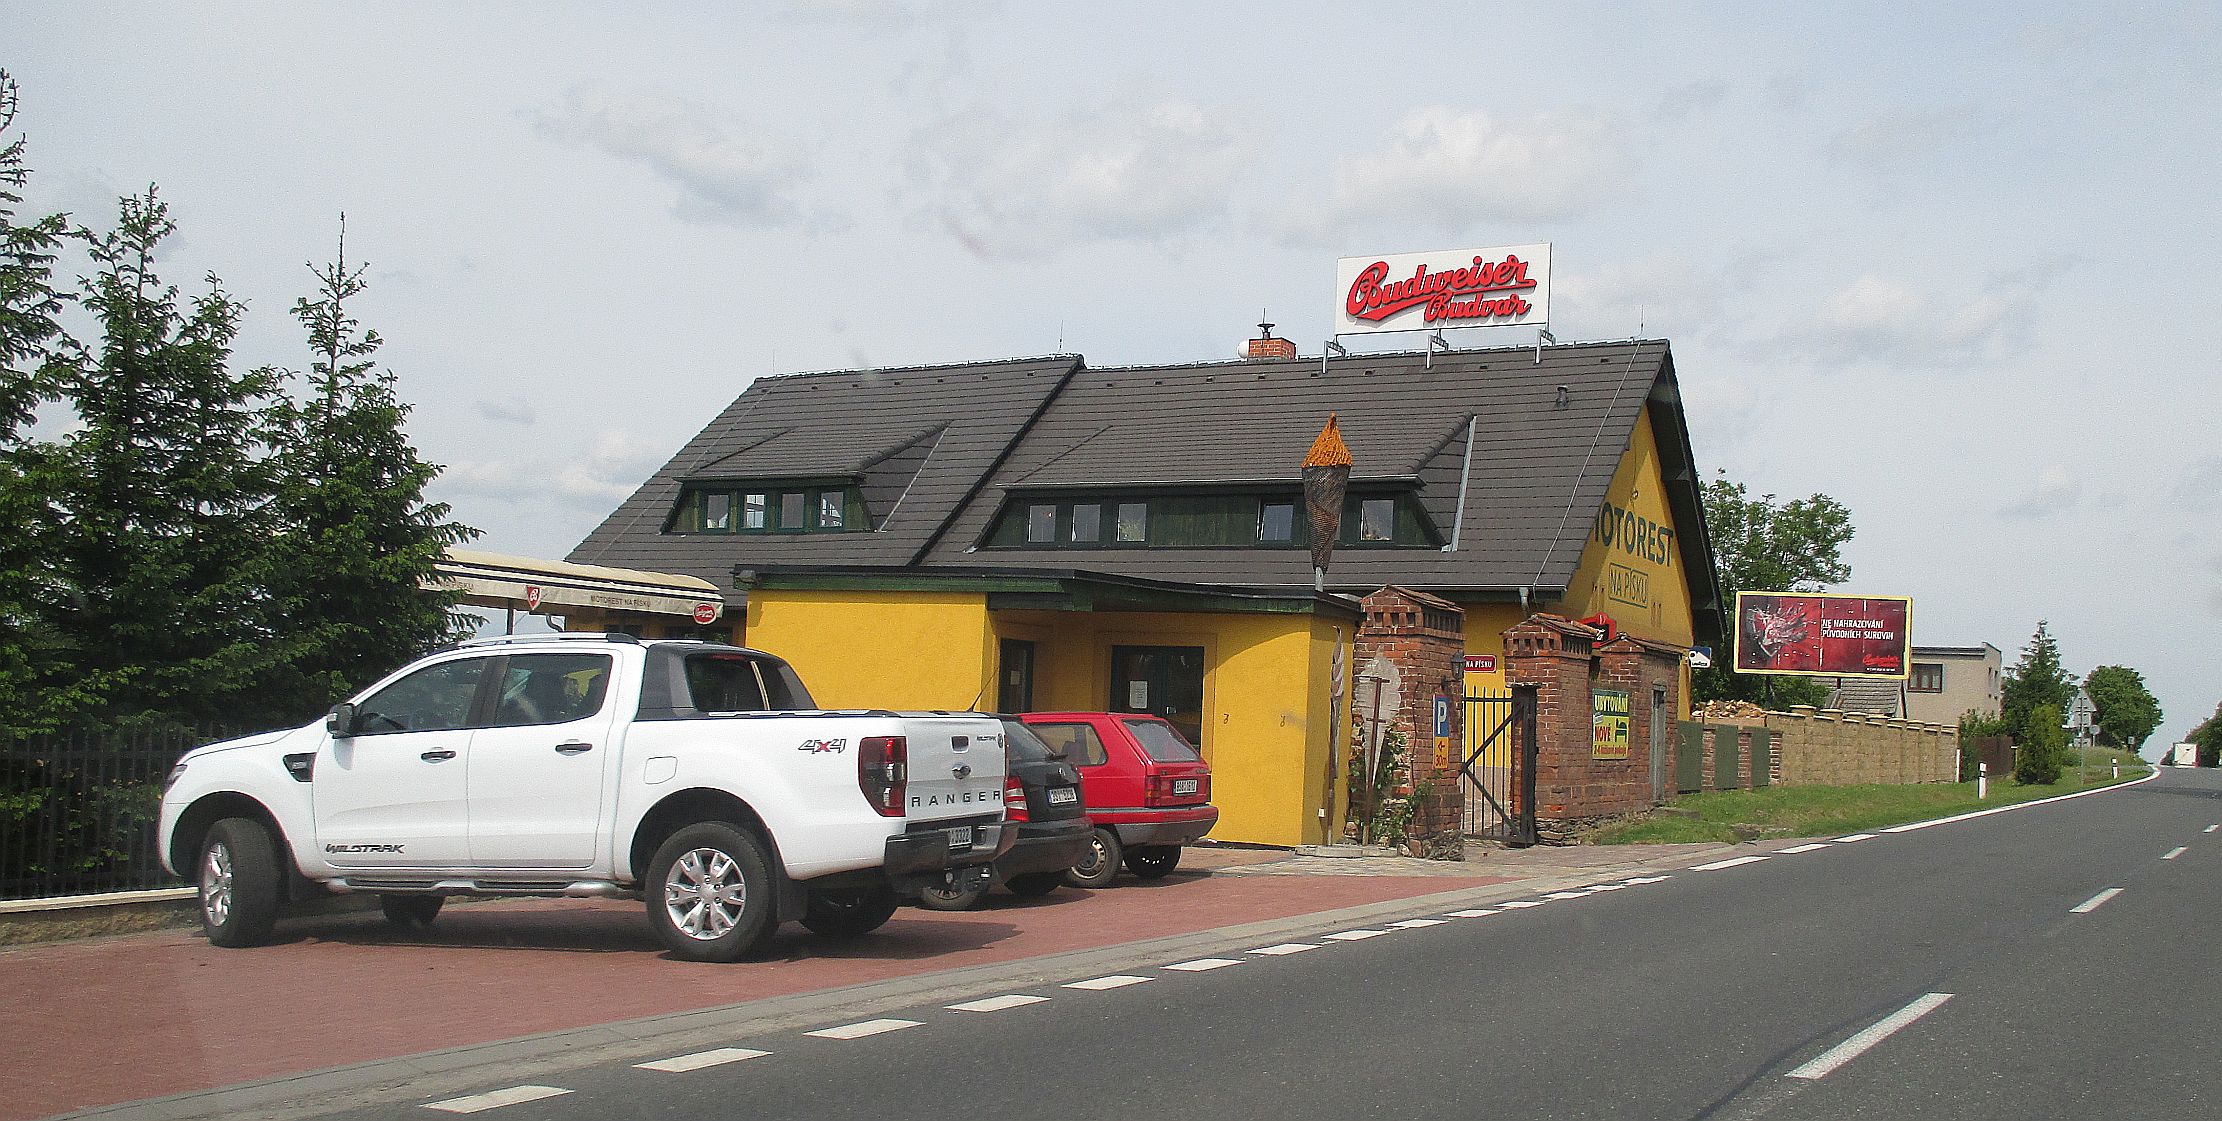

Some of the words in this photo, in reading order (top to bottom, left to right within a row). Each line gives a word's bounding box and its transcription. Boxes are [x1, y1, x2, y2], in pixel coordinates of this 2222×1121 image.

[1346, 254, 1537, 321] Budweiser
[1424, 293, 1532, 322] Budvar
[1610, 568, 1622, 597] NA
[1465, 660, 1474, 668] NA
[1475, 659, 1493, 668] PÍSKU
[1437, 700, 1448, 735] P
[1595, 723, 1611, 742] NOVÉ
[911, 790, 1001, 808] RANGER
